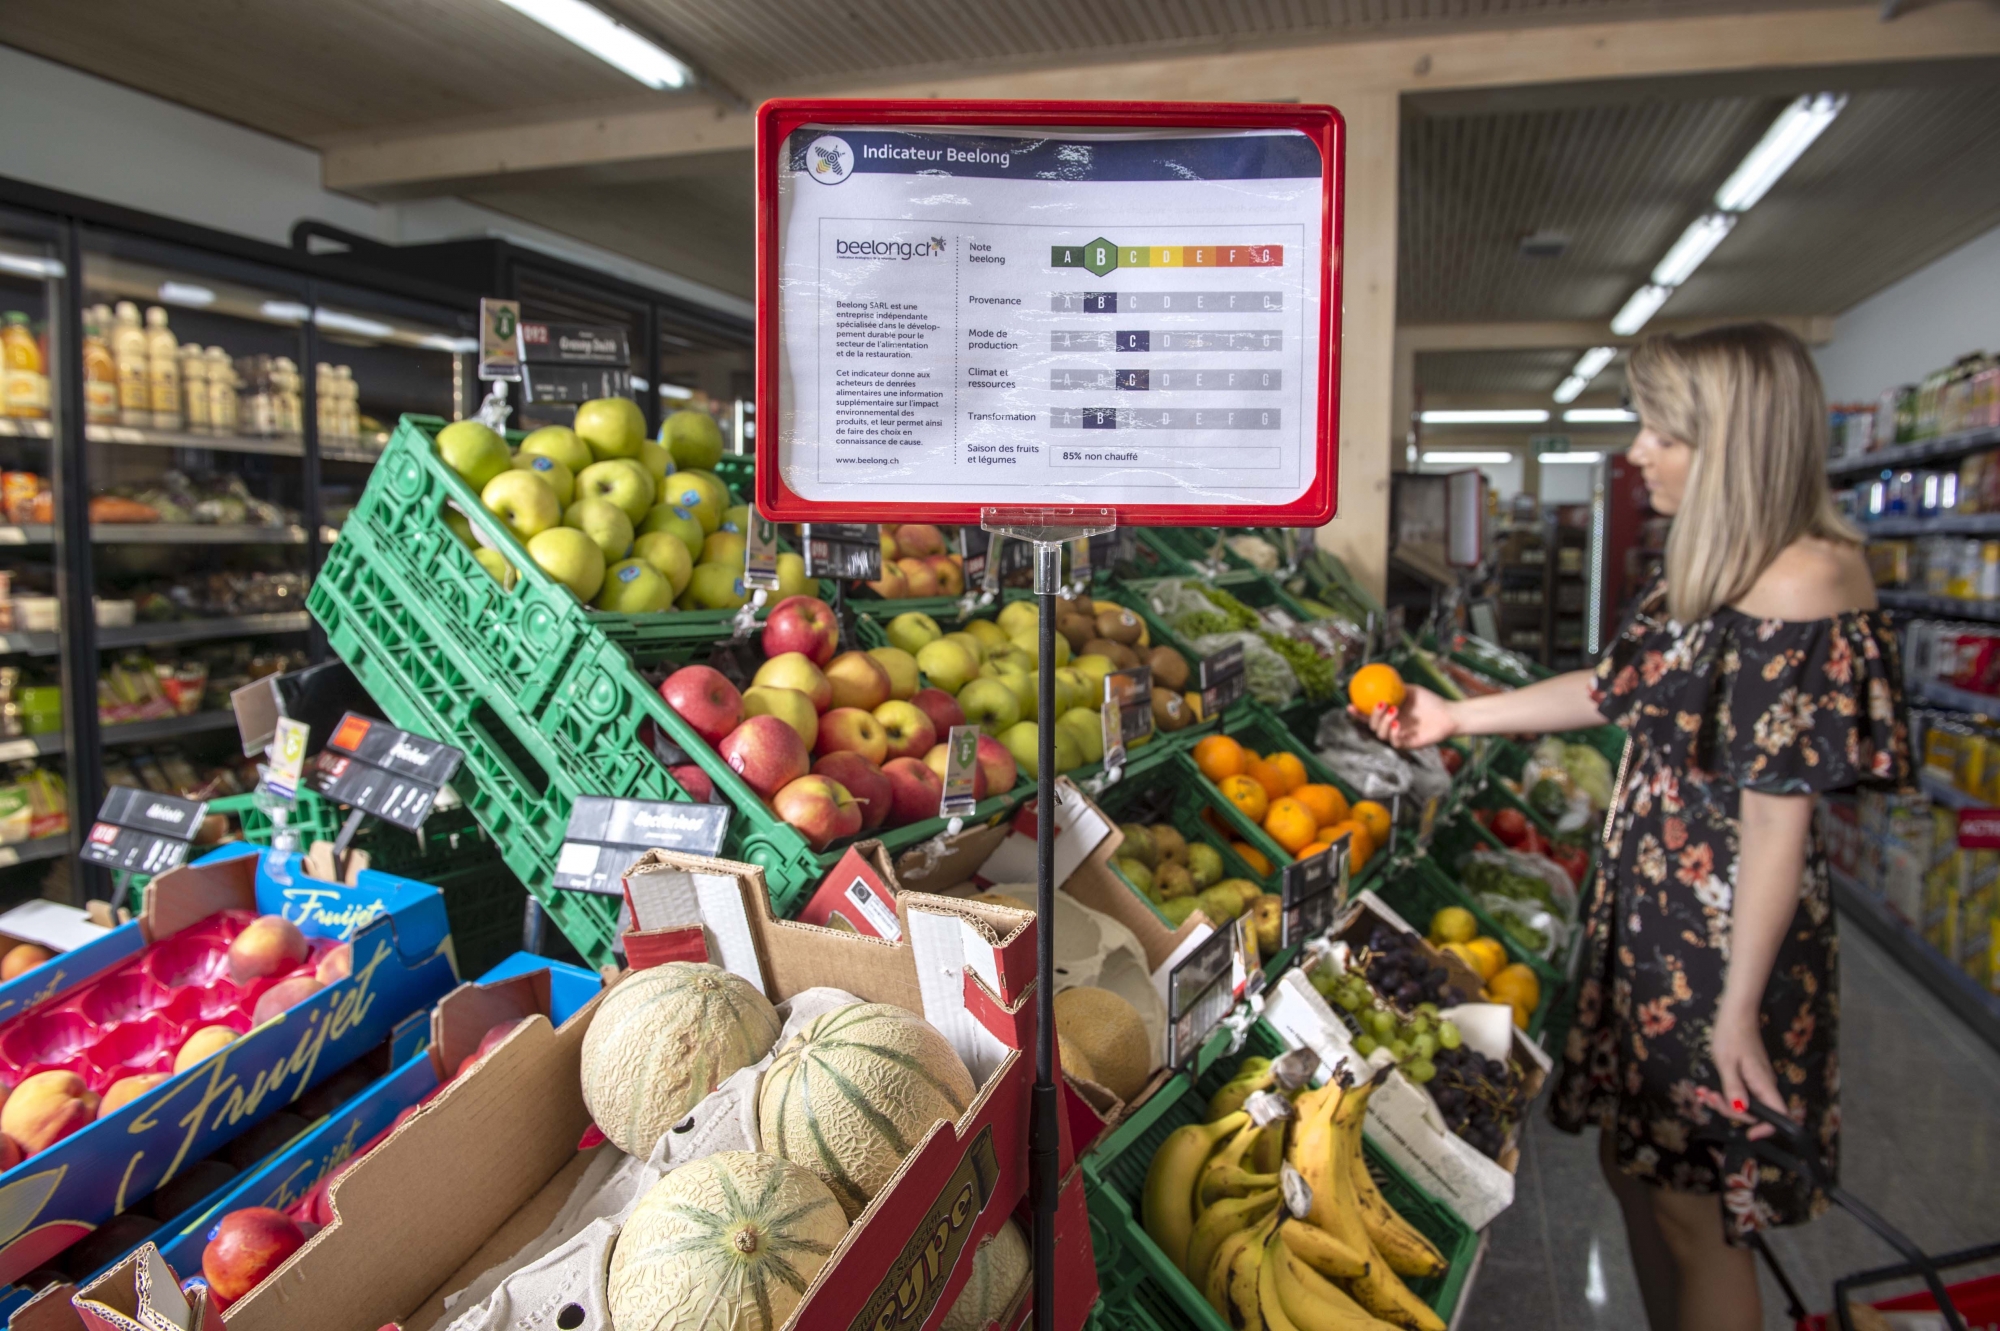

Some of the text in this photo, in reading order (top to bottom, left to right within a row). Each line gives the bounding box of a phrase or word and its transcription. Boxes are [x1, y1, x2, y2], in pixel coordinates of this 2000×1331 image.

[863, 144, 1010, 168] Indicateur Beelong
[969, 242, 992, 252] Note
[969, 254, 1006, 265] beelong
[1064, 247, 1270, 266] A B C D E F G
[969, 296, 1021, 305] Provenance
[1064, 296, 1271, 309] A B C D E F G
[837, 301, 868, 310] Beelong
[836, 312, 928, 321] entreprise indépendante
[837, 321, 877, 331] spécialisée
[907, 323, 940, 332] dévelop-
[868, 331, 896, 339] durable
[969, 329, 1008, 338] Mode de
[877, 341, 928, 349] l'alimentation
[969, 341, 1018, 350] production
[968, 368, 1008, 377] Climat et
[886, 380, 916, 388] denrées
[900, 390, 943, 398] information
[836, 399, 894, 407] supplémentaire
[909, 400, 939, 408] l'impact
[968, 412, 1036, 421] Transformation
[836, 418, 869, 426] produits,
[897, 420, 924, 428] permet
[968, 444, 1039, 453] Saison des fruits
[978, 455, 1016, 465] légumes
[1063, 452, 1082, 460] 85%
[1105, 453, 1138, 461] chauffé
[836, 457, 899, 466] www.beelong.ch
